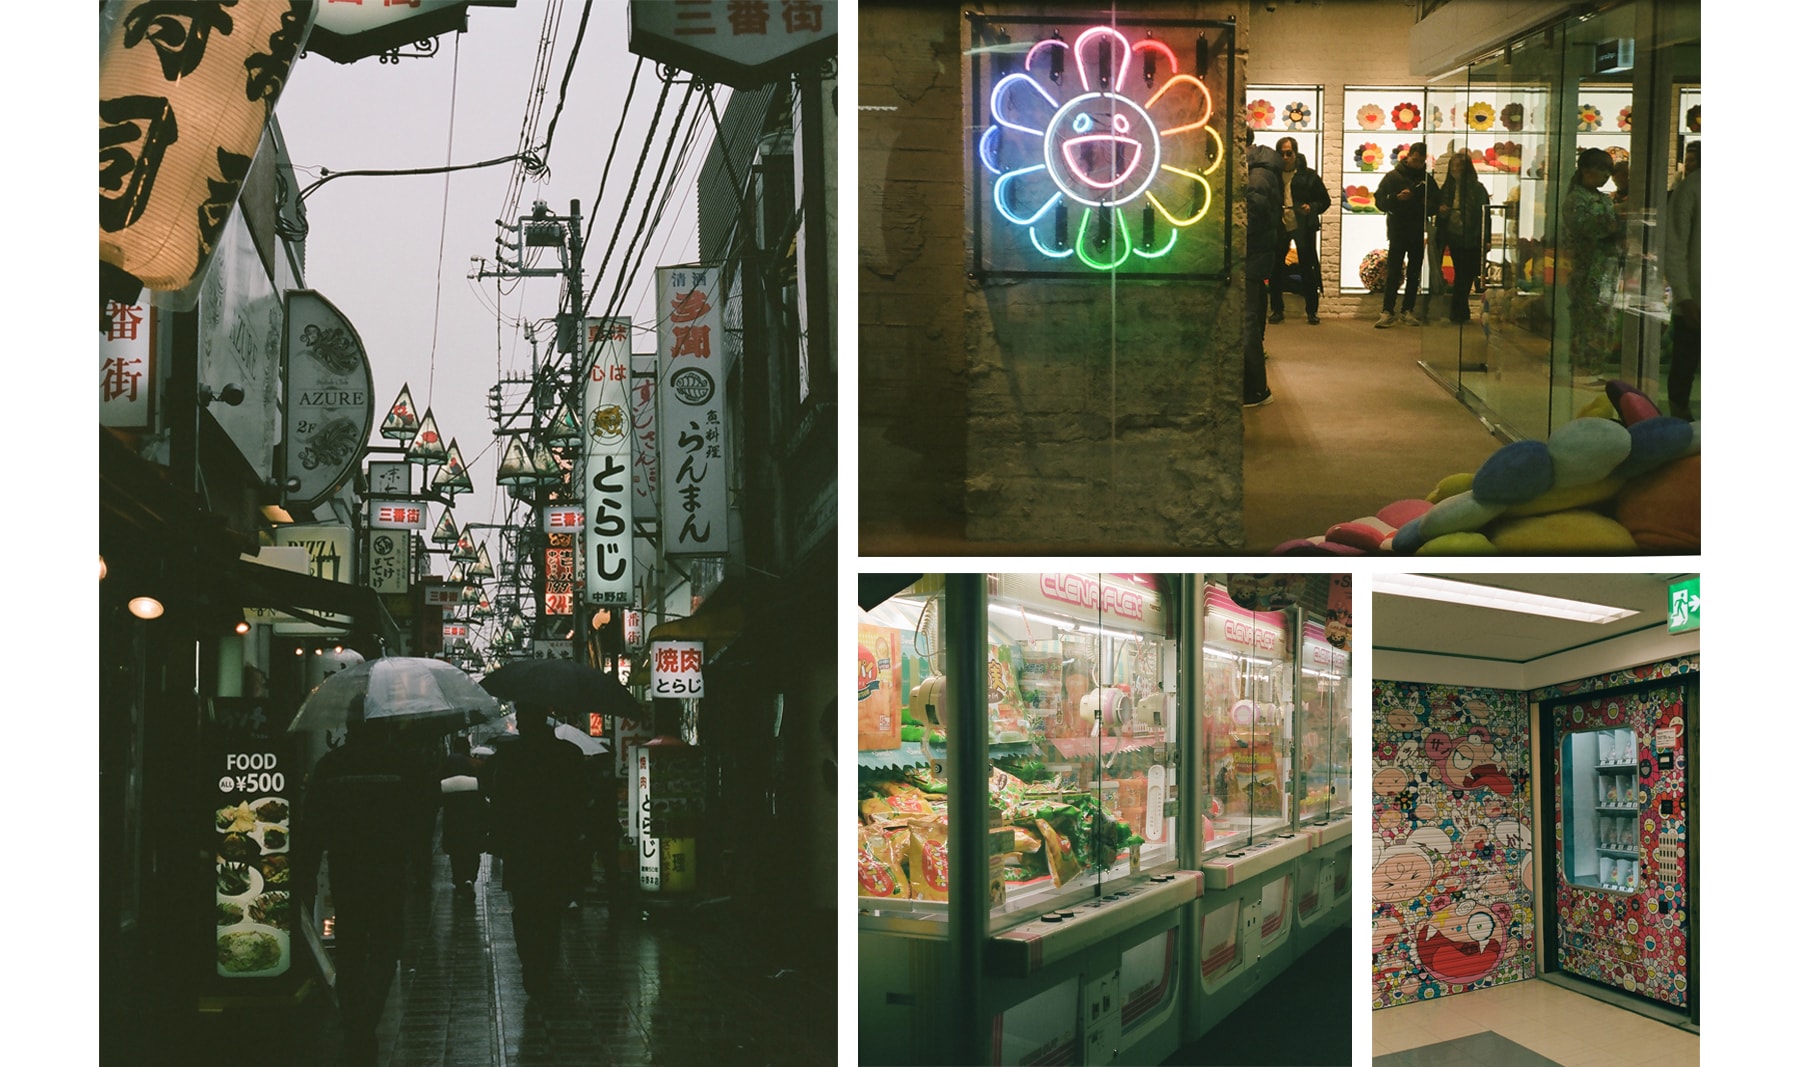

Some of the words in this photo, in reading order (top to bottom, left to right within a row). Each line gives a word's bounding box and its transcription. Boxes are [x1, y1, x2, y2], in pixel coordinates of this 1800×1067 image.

[672, 272, 707, 287] 清酒
[299, 392, 364, 405] AZURE
[297, 420, 317, 433] 2F
[676, 421, 711, 544] らんまん
[379, 508, 421, 523] 三番街
[593, 455, 627, 581] とらじ
[592, 592, 628, 602] 中野店
[655, 648, 703, 673] 焼肉
[656, 678, 702, 694] とらじ
[226, 753, 277, 770] FOOD
[236, 772, 285, 792] ¥500
